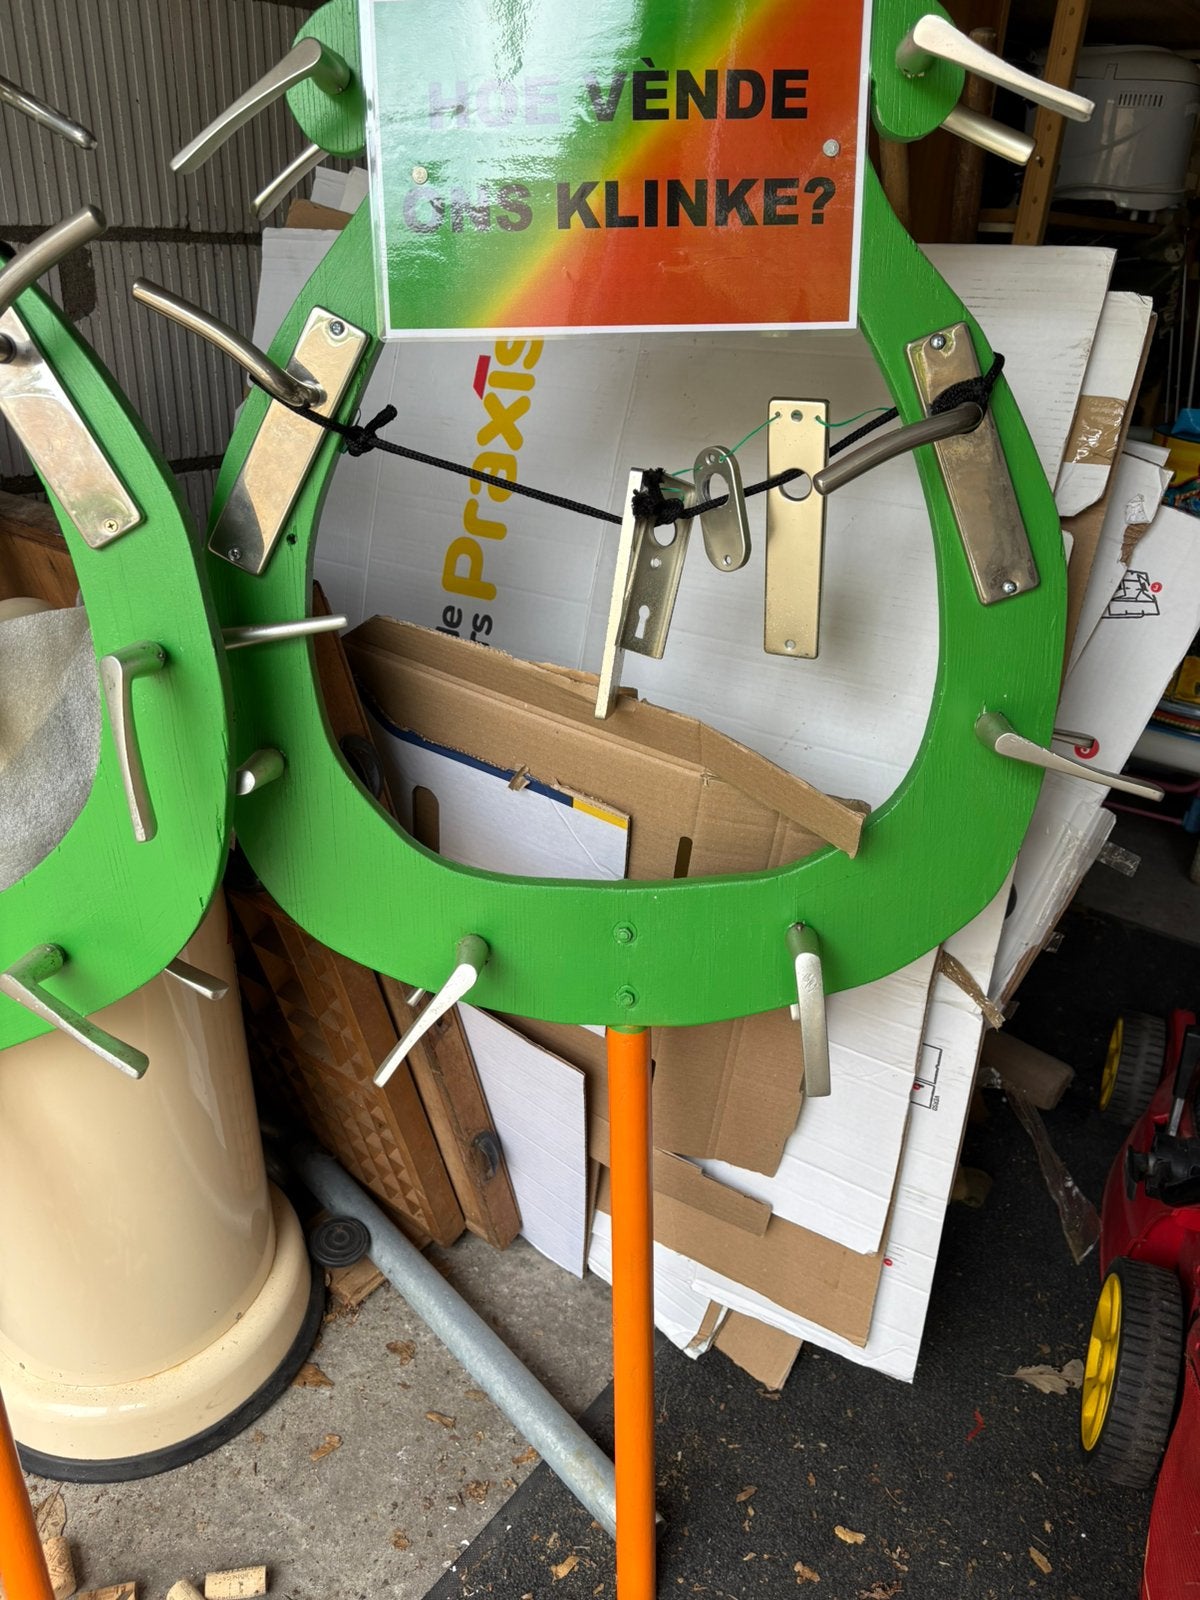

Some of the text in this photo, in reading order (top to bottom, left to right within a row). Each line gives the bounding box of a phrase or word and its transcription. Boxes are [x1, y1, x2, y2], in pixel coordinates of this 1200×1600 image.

[428, 57, 809, 130] HOE VÈNDE
[403, 177, 837, 234] ONS KLINKE?
[441, 336, 544, 601] Praxis
